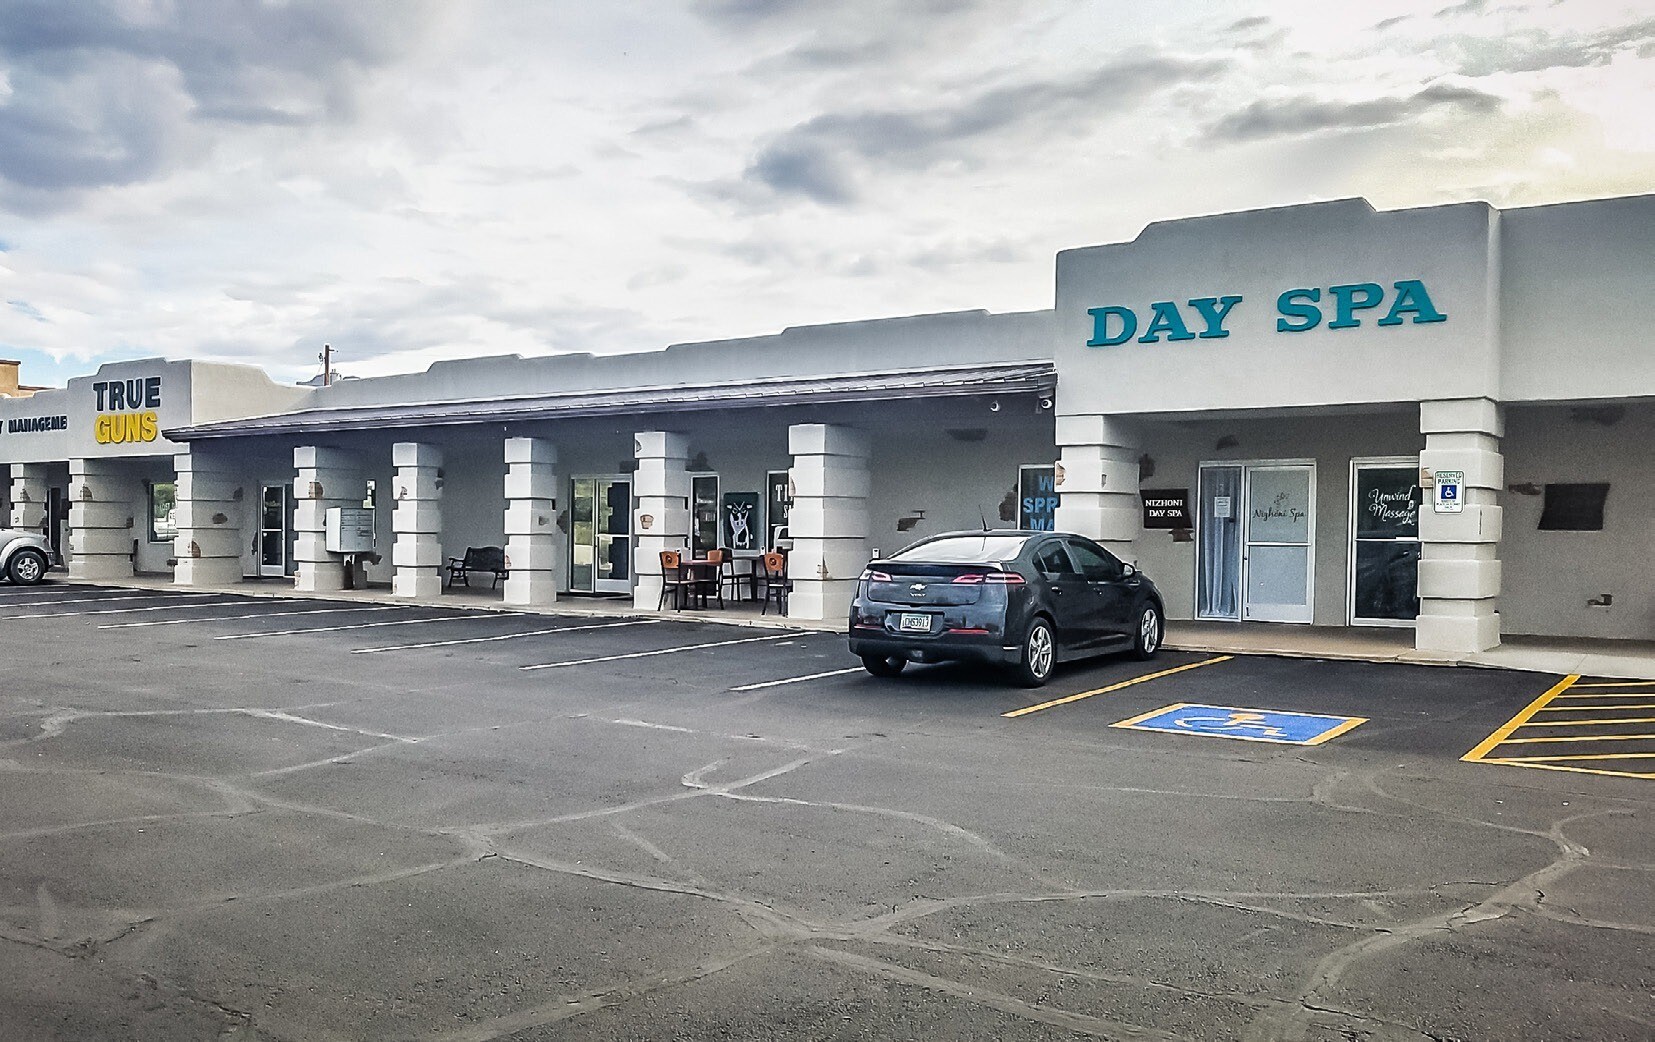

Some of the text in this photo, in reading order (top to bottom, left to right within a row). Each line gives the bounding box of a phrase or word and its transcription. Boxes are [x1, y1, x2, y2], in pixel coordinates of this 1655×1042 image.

[1086, 279, 1447, 347] DAY SPA
[93, 377, 161, 411] TRUE
[8, 415, 67, 433] MANAGEME
[95, 412, 158, 444] GUNS
[1145, 499, 1183, 507] NIZHONI
[1368, 484, 1417, 505] Unwind
[1023, 497, 1058, 513] SPR
[1149, 509, 1183, 517] DAY SPA
[1368, 503, 1416, 526] Massage
[1290, 507, 1306, 523] Spa
